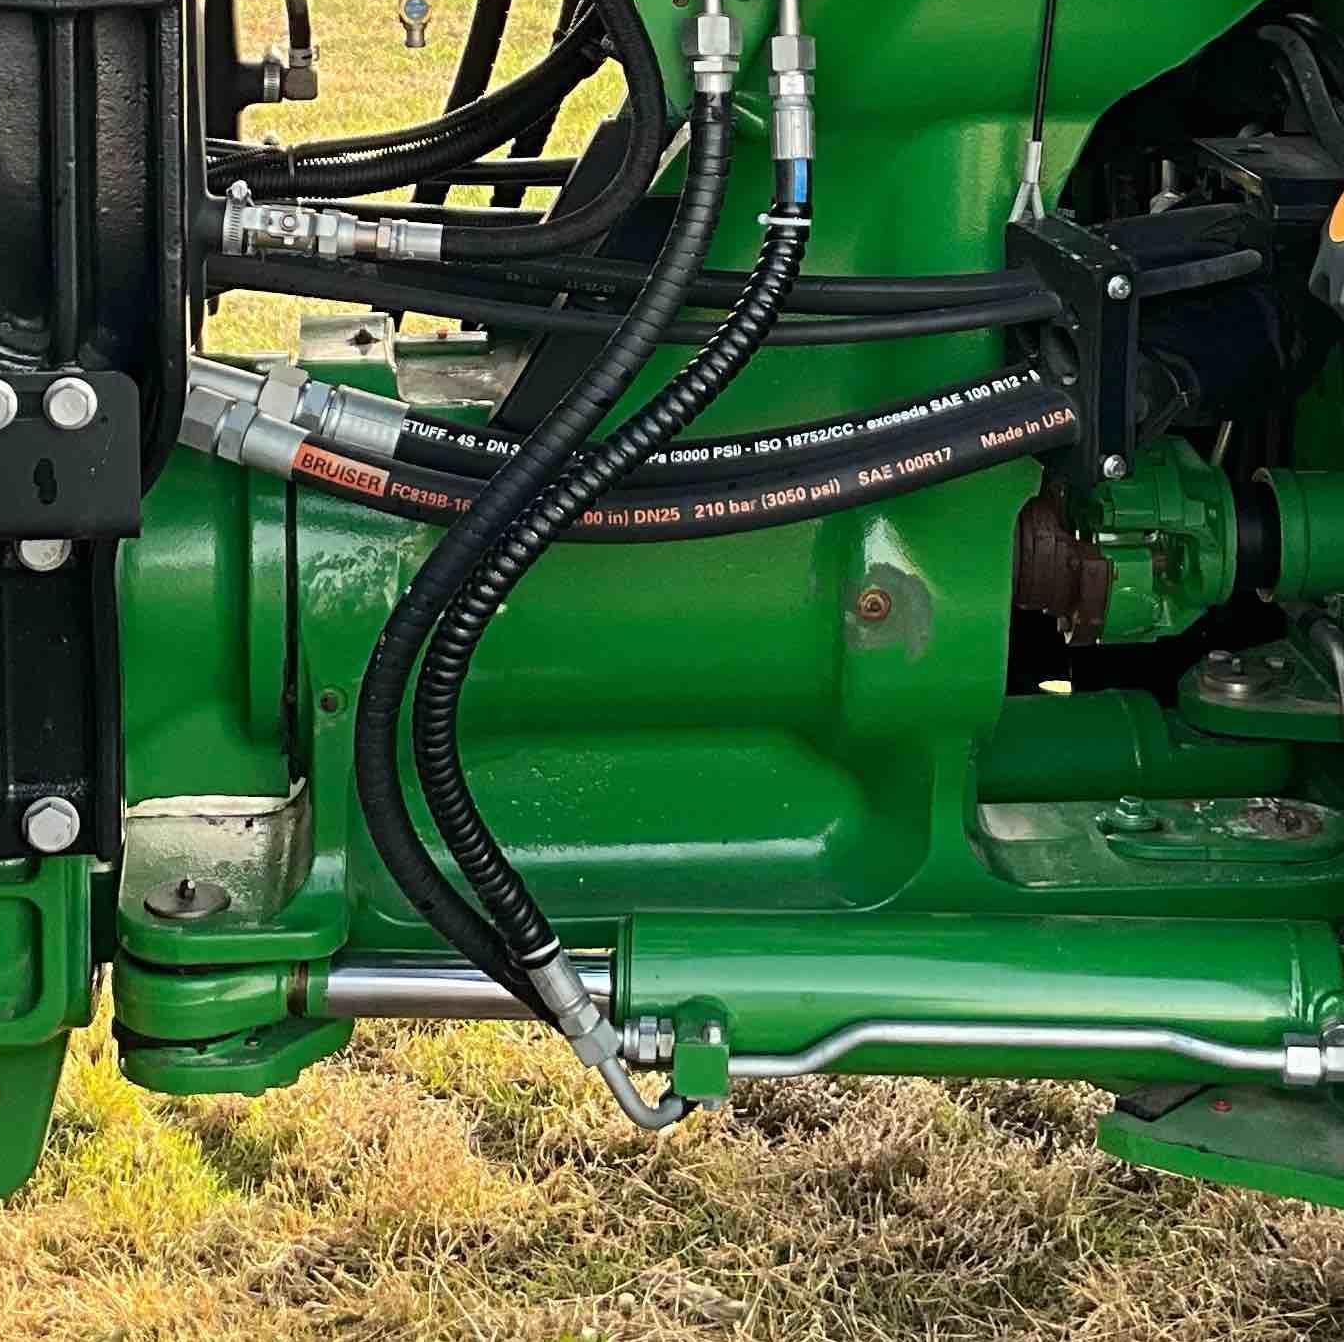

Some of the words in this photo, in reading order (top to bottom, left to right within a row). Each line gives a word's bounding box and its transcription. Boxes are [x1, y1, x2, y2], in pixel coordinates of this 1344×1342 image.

[457, 434, 476, 448] 4S
[486, 439, 509, 454] DN
[671, 448, 709, 463] (3000
[713, 445, 741, 459] PSI)
[755, 439, 781, 454] ISO
[787, 422, 854, 448] 18752/CC
[866, 405, 928, 431] exceeds
[930, 394, 964, 413] SAE
[965, 384, 991, 403] 100
[992, 375, 1021, 393] R12
[301, 452, 382, 492] BRUISER
[607, 509, 628, 527] in)
[634, 506, 681, 524] DN25
[694, 502, 724, 520] 210
[729, 498, 756, 515] bar
[761, 487, 807, 510] (3050
[810, 477, 841, 500] psi)
[857, 465, 894, 487] SAE
[896, 446, 953, 476] 100R17
[980, 426, 1024, 448] Made
[1024, 420, 1041, 435] in
[1041, 407, 1077, 429] USA
